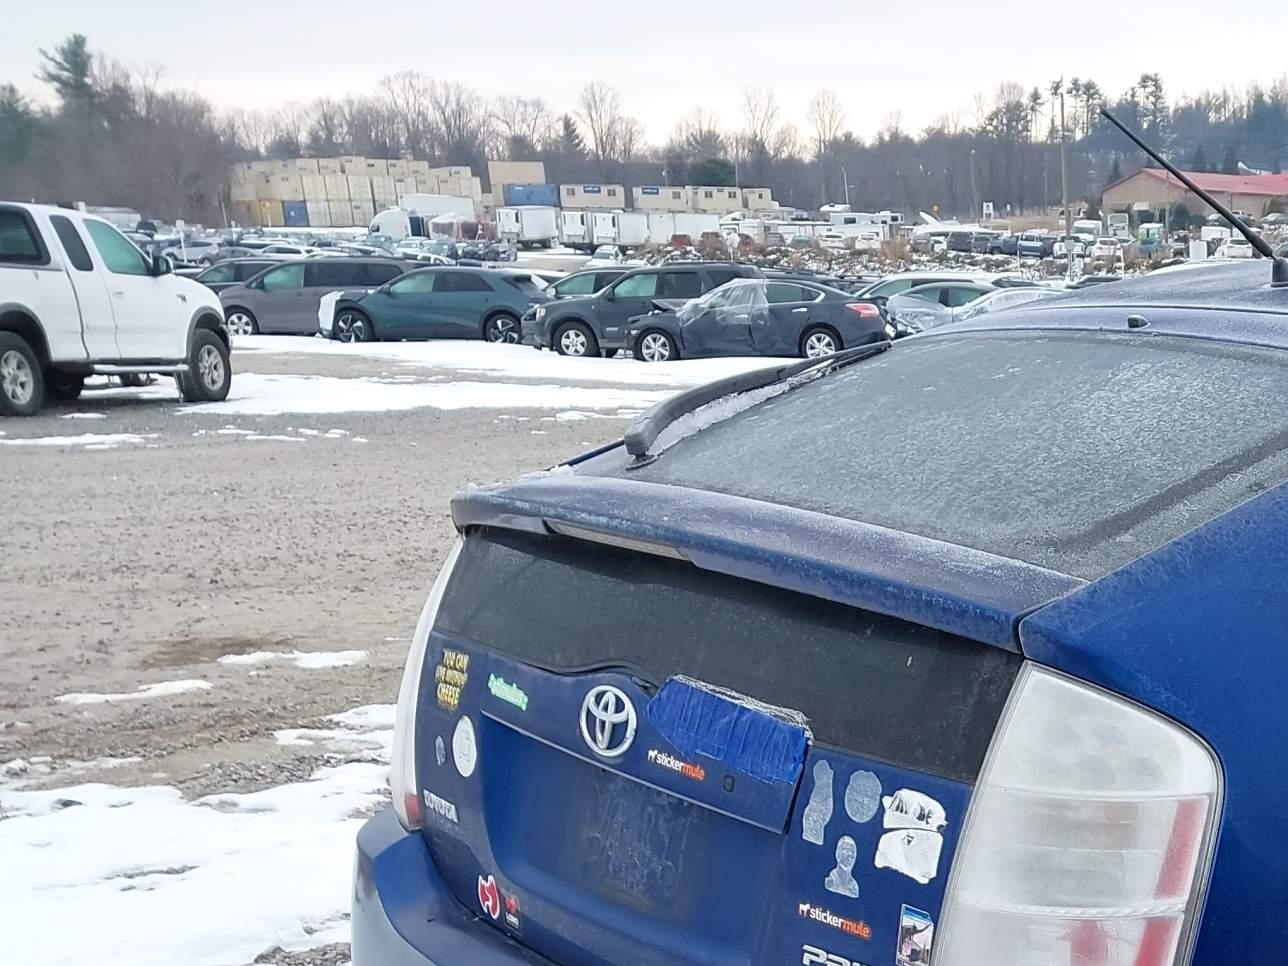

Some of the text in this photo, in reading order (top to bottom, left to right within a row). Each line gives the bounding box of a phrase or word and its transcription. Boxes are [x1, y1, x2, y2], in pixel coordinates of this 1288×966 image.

[656, 752, 705, 781] stickermule
[423, 788, 460, 824] TOYOTA
[810, 908, 870, 937] stickermule
